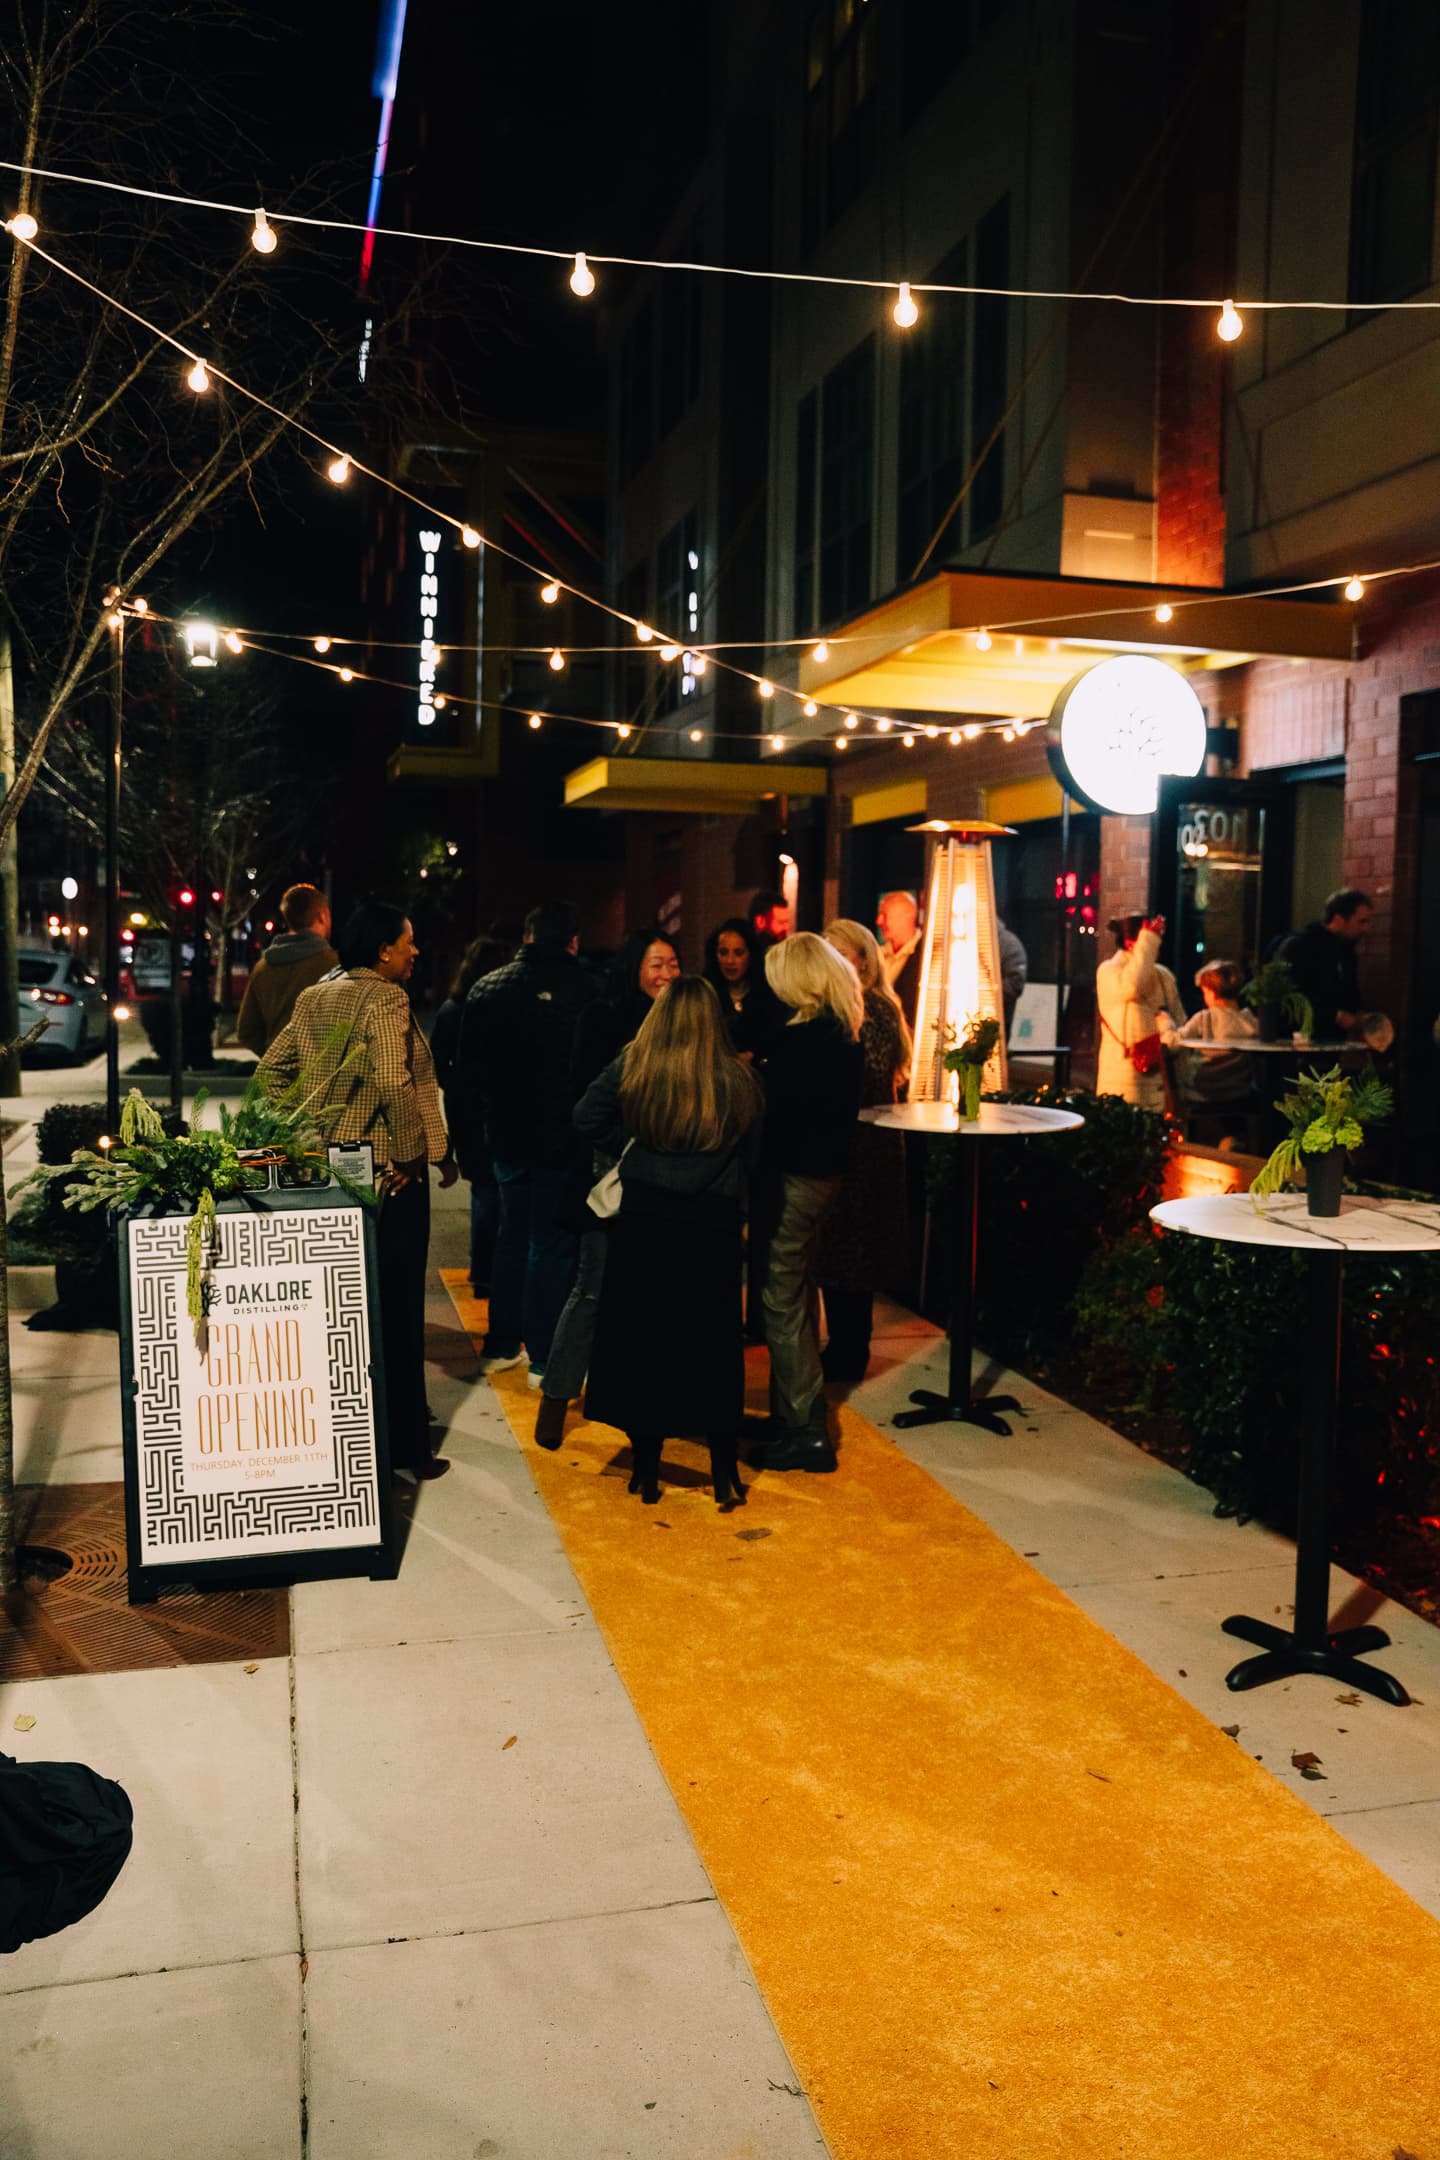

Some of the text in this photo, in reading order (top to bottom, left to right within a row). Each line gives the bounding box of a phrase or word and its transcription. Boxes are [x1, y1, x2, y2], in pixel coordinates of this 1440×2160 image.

[225, 1280, 313, 1304] OAKLORE
[233, 1304, 300, 1315] DISTILLING
[206, 1319, 302, 1388] GRAND
[198, 1386, 317, 1455] OPENING
[248, 1454, 301, 1467] DECEMBER
[304, 1452, 328, 1463] 11TH
[244, 1469, 276, 1481] 5-8PM
